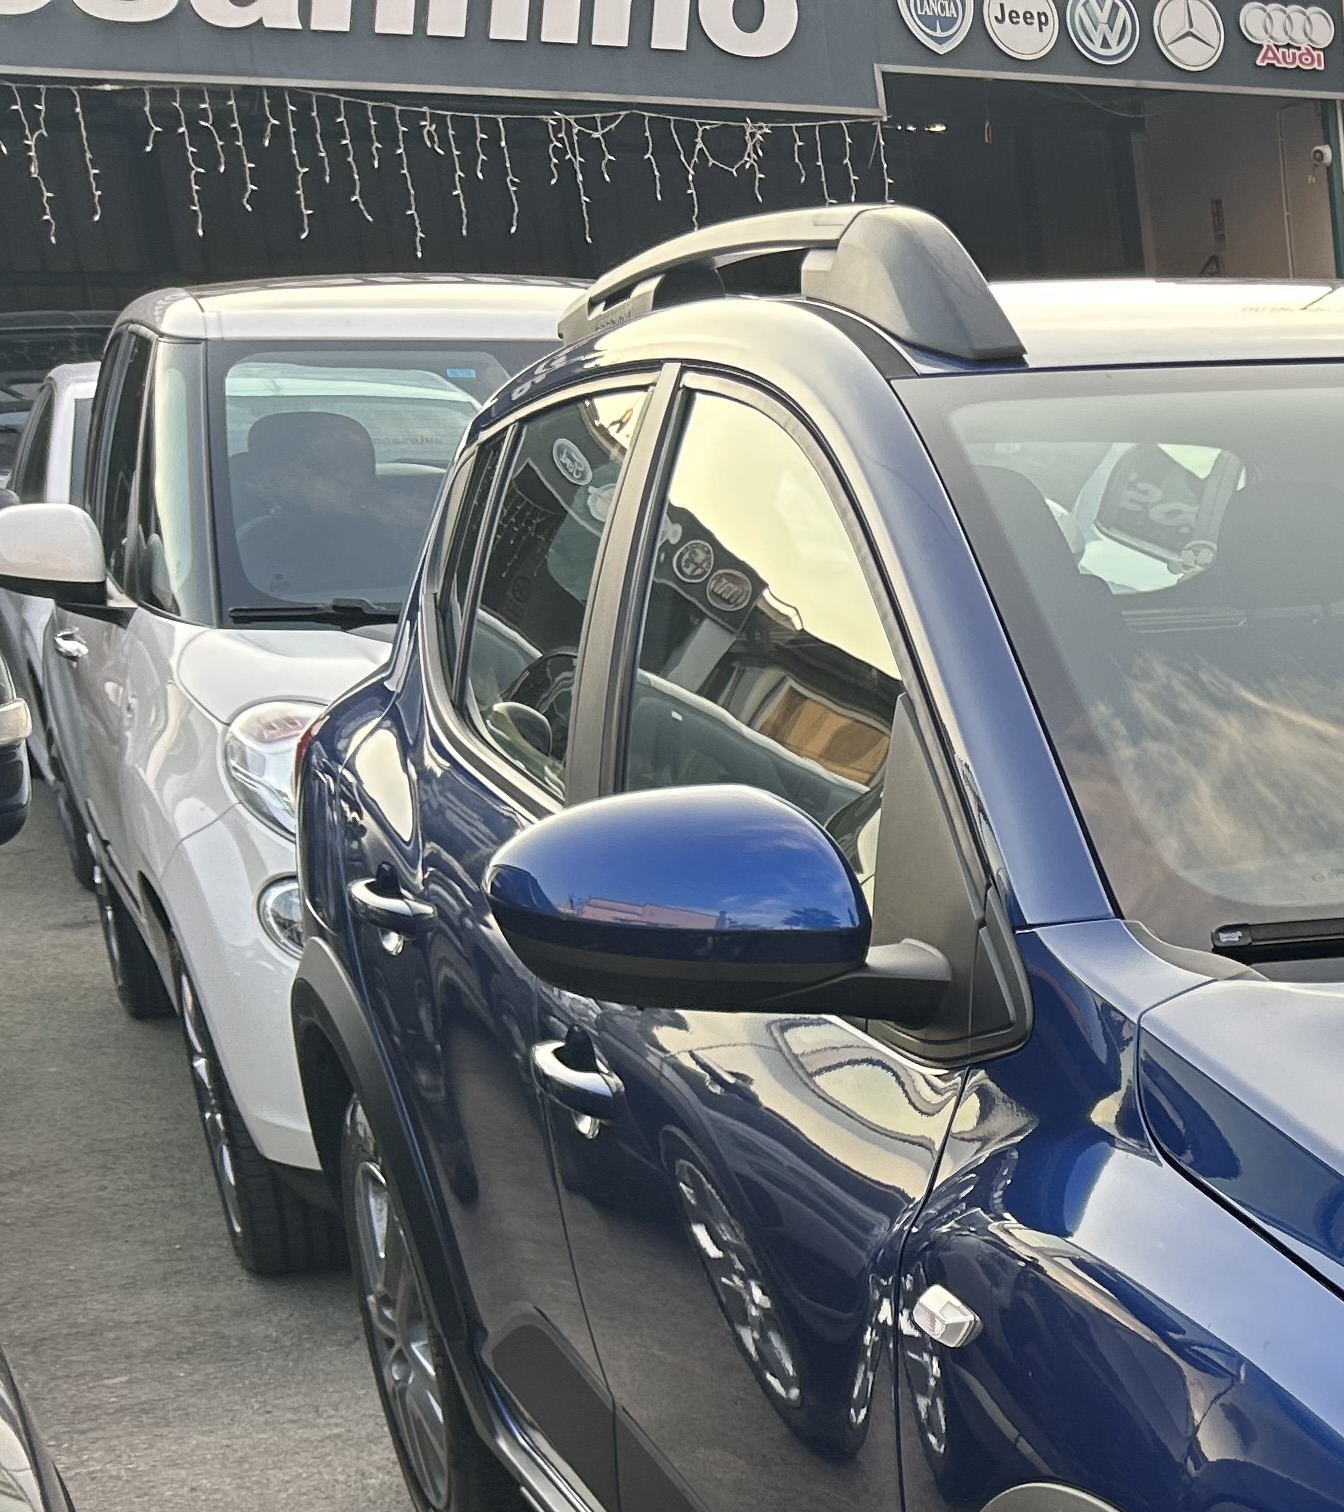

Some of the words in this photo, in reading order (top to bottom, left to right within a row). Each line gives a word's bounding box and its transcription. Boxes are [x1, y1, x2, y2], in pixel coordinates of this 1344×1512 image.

[916, 0, 958, 18] LANCIA
[993, 2, 1049, 33] Jeep
[1258, 43, 1323, 68] Audi
